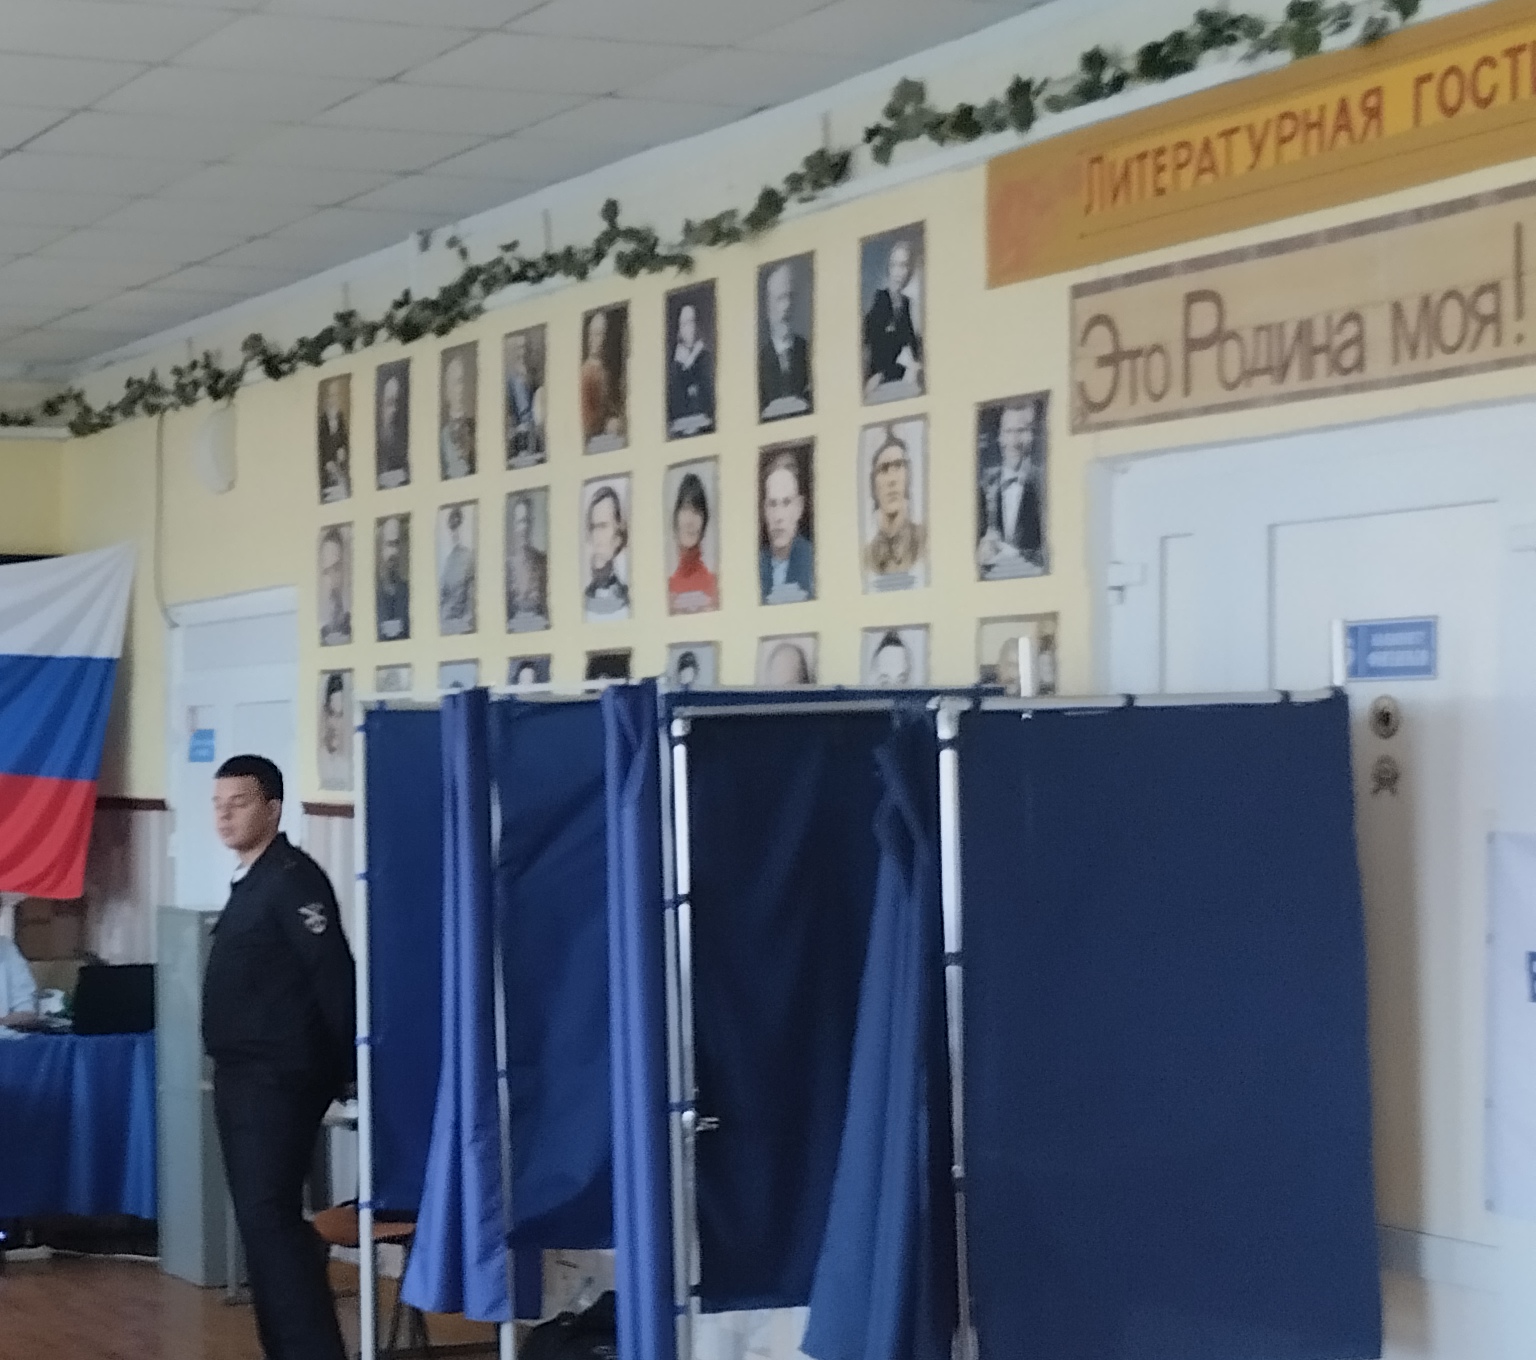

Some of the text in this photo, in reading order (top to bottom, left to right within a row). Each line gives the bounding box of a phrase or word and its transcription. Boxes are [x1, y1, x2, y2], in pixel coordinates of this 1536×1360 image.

[1084, 86, 1384, 216] ЛИТЕРАТУРНАЯ
[1077, 313, 1171, 414] Это
[1182, 289, 1366, 398] Родина
